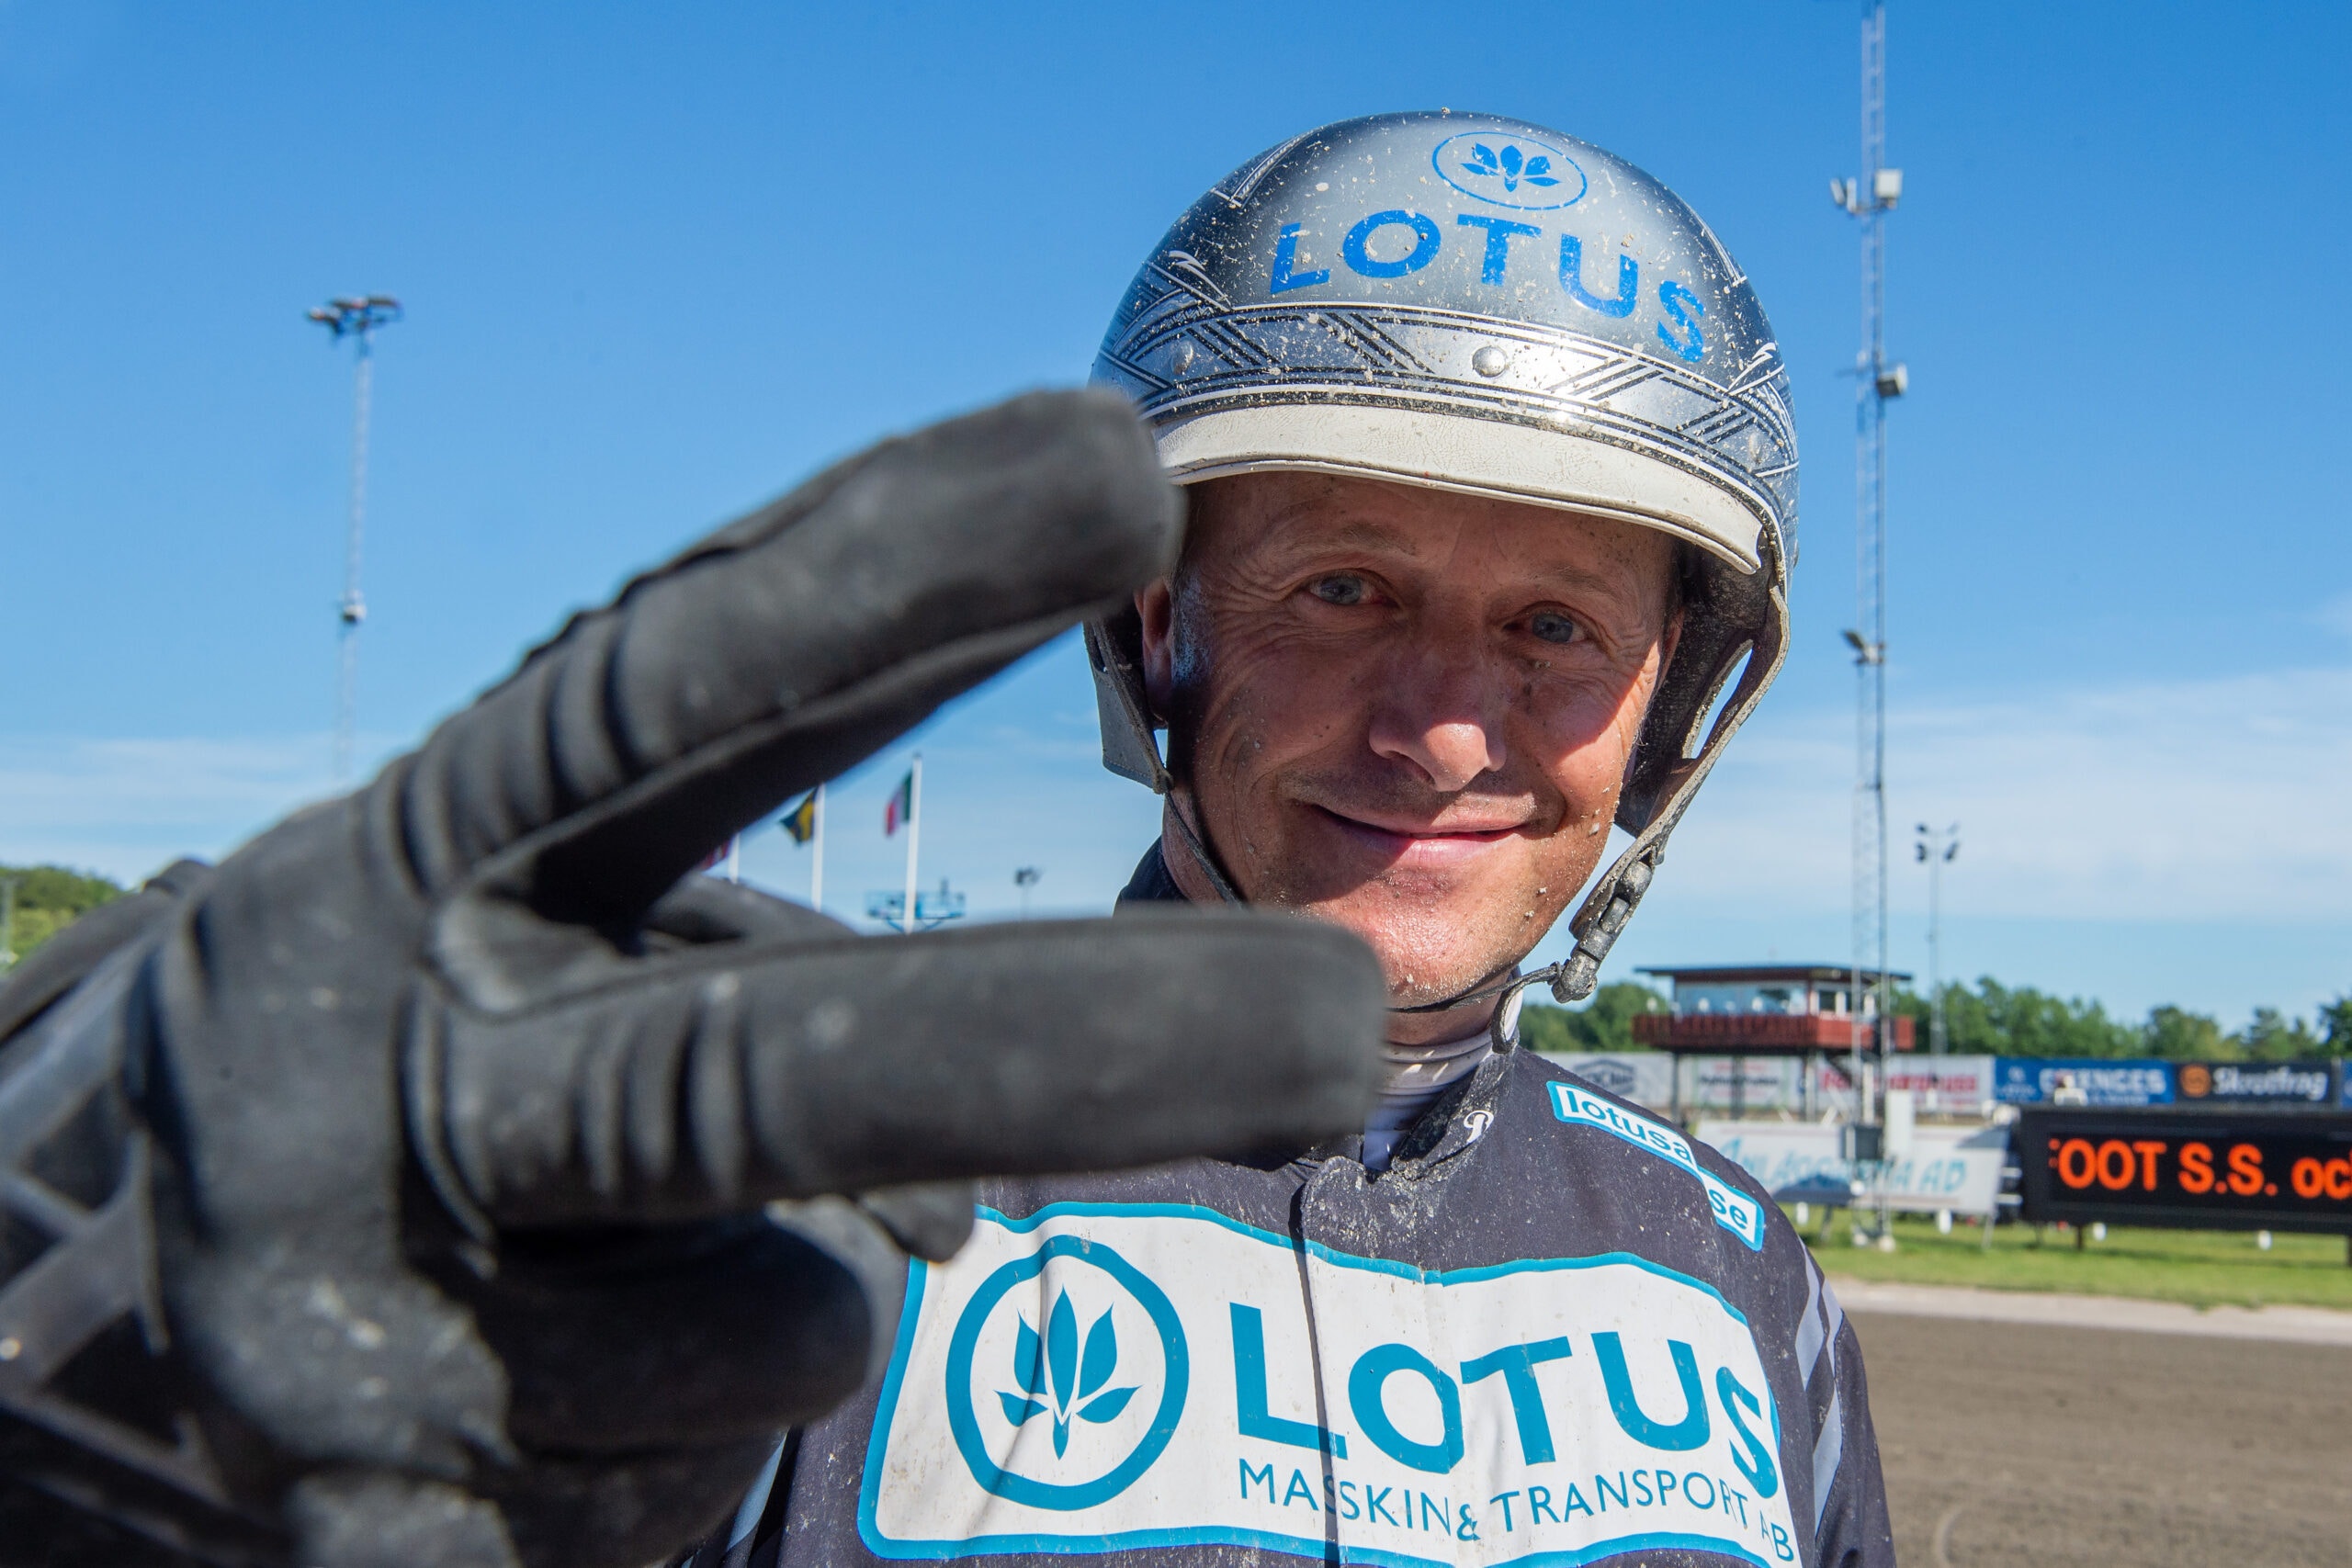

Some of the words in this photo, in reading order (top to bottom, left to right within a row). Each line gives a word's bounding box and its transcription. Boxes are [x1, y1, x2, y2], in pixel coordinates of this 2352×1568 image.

[1270, 209, 1706, 363] LOTUS
[2178, 1142, 2278, 1196] S.S.
[1228, 1302, 1780, 1499] LOTUS
[1489, 1469, 1748, 1532] TRANSPORT
[1758, 1509, 1795, 1562] AB
